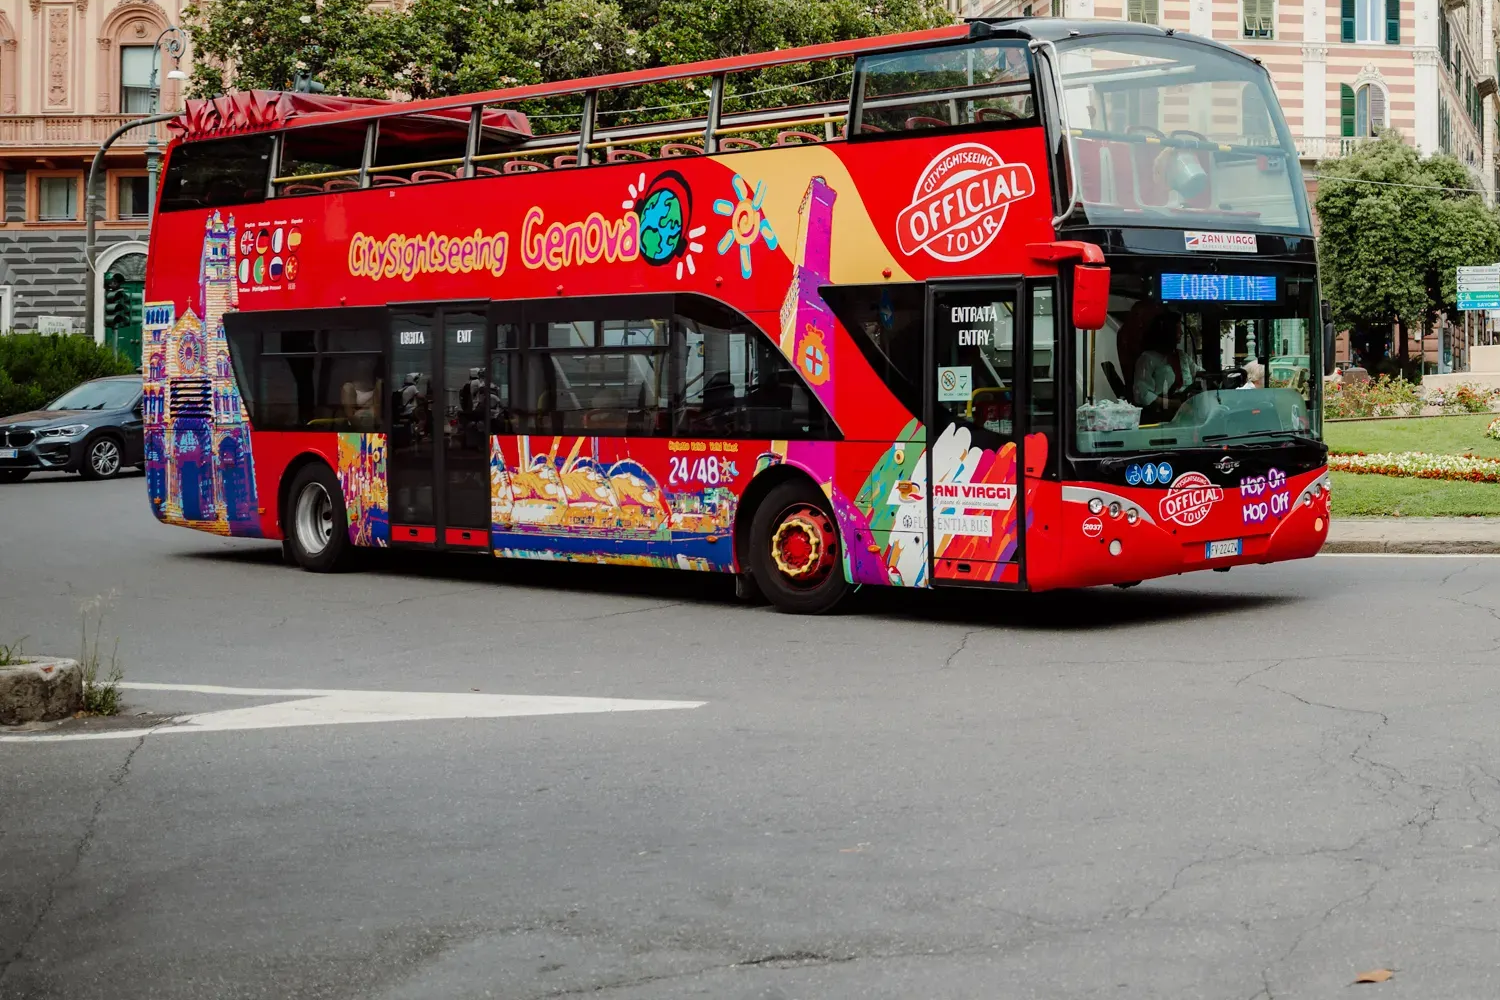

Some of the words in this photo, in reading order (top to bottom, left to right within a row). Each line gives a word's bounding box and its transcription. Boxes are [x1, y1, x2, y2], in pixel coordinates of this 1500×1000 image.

[924, 152, 994, 192] CITYSIGHTSEEING
[910, 170, 1025, 241] OFFICIAL
[521, 206, 640, 271] Genova
[946, 215, 998, 252] TOUR
[1202, 234, 1224, 244] ZANI
[951, 306, 998, 322] ENTRATA
[400, 331, 425, 345] USCITA
[457, 329, 473, 344] EXIT
[958, 329, 991, 345] ENTRY
[669, 456, 720, 484] 24/48
[932, 485, 958, 498] ANI
[962, 486, 1010, 499] VIAGGI
[1241, 476, 1265, 496] Hop
[1268, 467, 1286, 487] On
[1166, 487, 1219, 514] OFFICIAL
[1242, 503, 1268, 522] Hop
[1270, 491, 1289, 514] Off
[913, 516, 969, 531] FLOENTIA
[970, 518, 989, 533] BUS
[1183, 508, 1208, 523] TOUR
[1084, 523, 1102, 531] 2037
